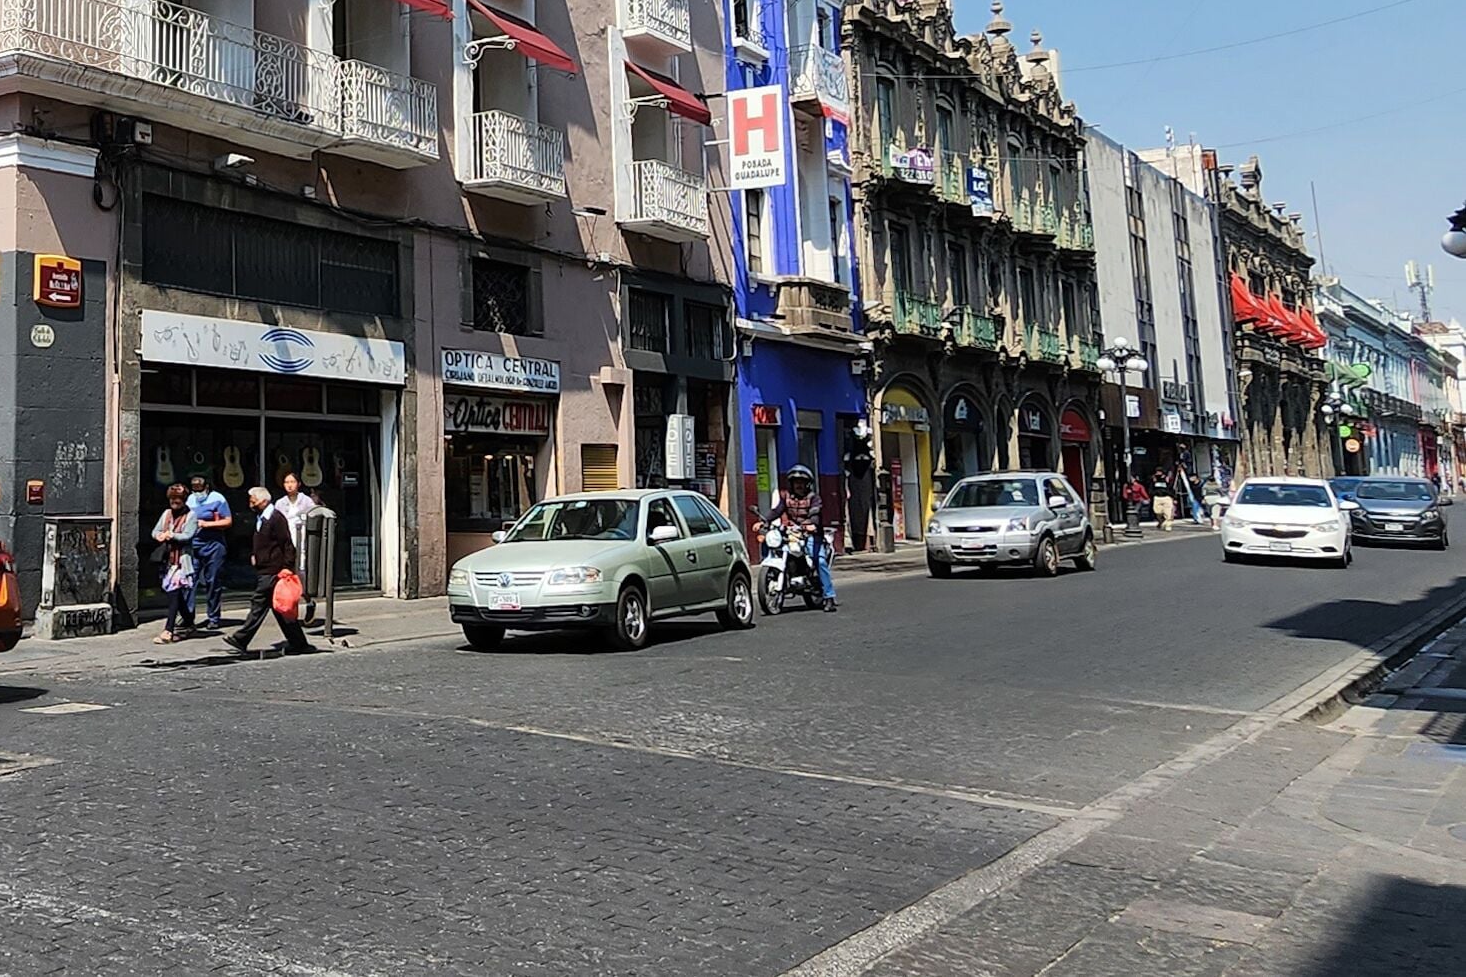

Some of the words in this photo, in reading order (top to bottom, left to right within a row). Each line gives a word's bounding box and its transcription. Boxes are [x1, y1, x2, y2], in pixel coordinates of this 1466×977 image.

[733, 94, 779, 156] H
[741, 159, 772, 170] POSADA
[734, 168, 780, 180] GUADALUPE
[445, 352, 493, 370] OPTICA
[503, 358, 555, 377] CENTRAL
